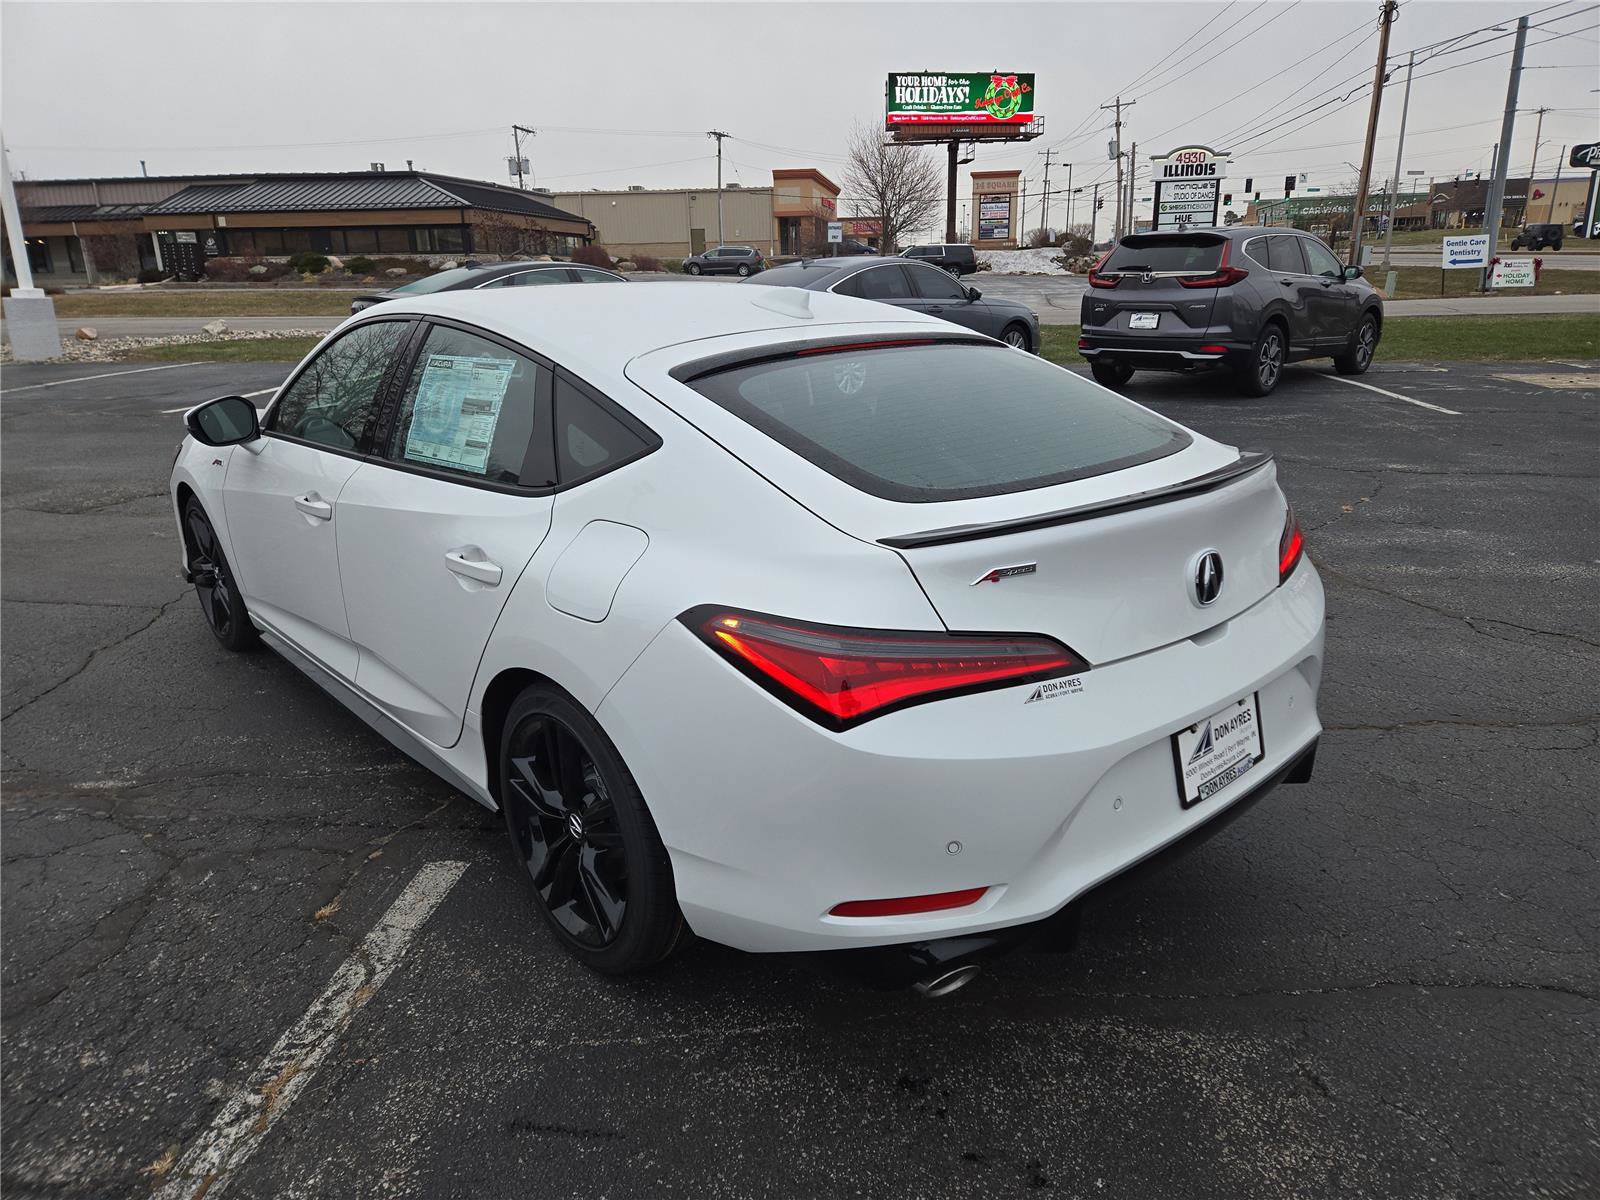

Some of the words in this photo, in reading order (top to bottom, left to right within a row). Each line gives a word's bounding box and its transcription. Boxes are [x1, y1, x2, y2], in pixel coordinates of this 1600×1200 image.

[896, 76, 920, 86] YOUR
[921, 76, 947, 86] HOME
[895, 86, 970, 103] HOLIDAYS!
[1176, 152, 1206, 164] 4930
[1163, 163, 1216, 177] ILLINOIS
[1197, 191, 1215, 199] DANCE
[1174, 214, 1193, 222] HUE
[1446, 239, 1468, 247] Gentle
[1449, 249, 1482, 257] Dentistry
[1042, 682, 1059, 693] DON
[1059, 678, 1082, 690] AYRES
[1214, 721, 1231, 741] DON
[1230, 708, 1252, 732] AYRES
[1204, 781, 1219, 796] DON
[1218, 767, 1238, 787] AYRES
